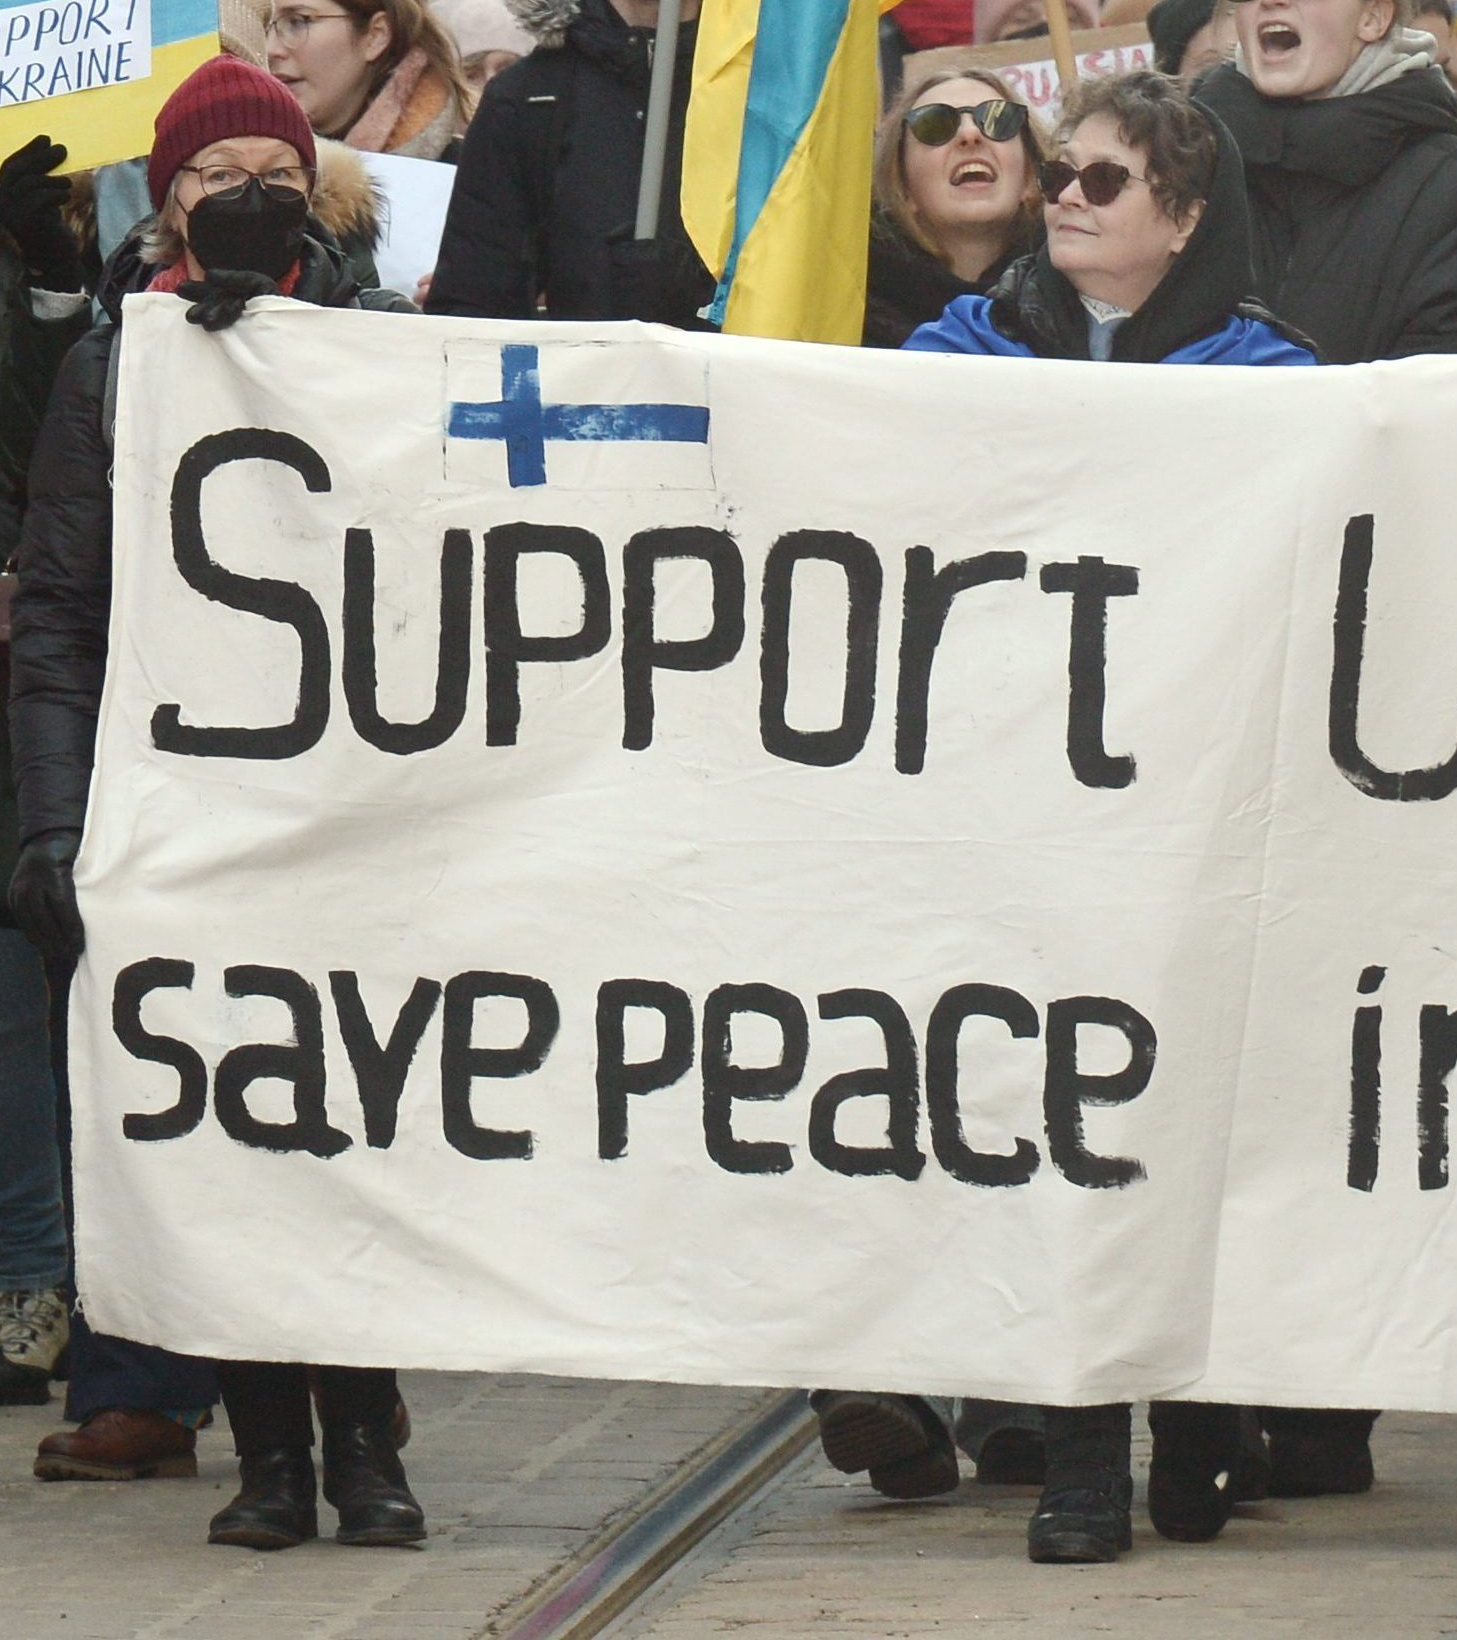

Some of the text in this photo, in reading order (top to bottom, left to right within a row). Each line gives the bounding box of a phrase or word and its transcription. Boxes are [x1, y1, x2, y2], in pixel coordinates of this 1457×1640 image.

[150, 426, 1140, 790] Support
[112, 957, 561, 1161] save
[595, 975, 1158, 1190] peace
